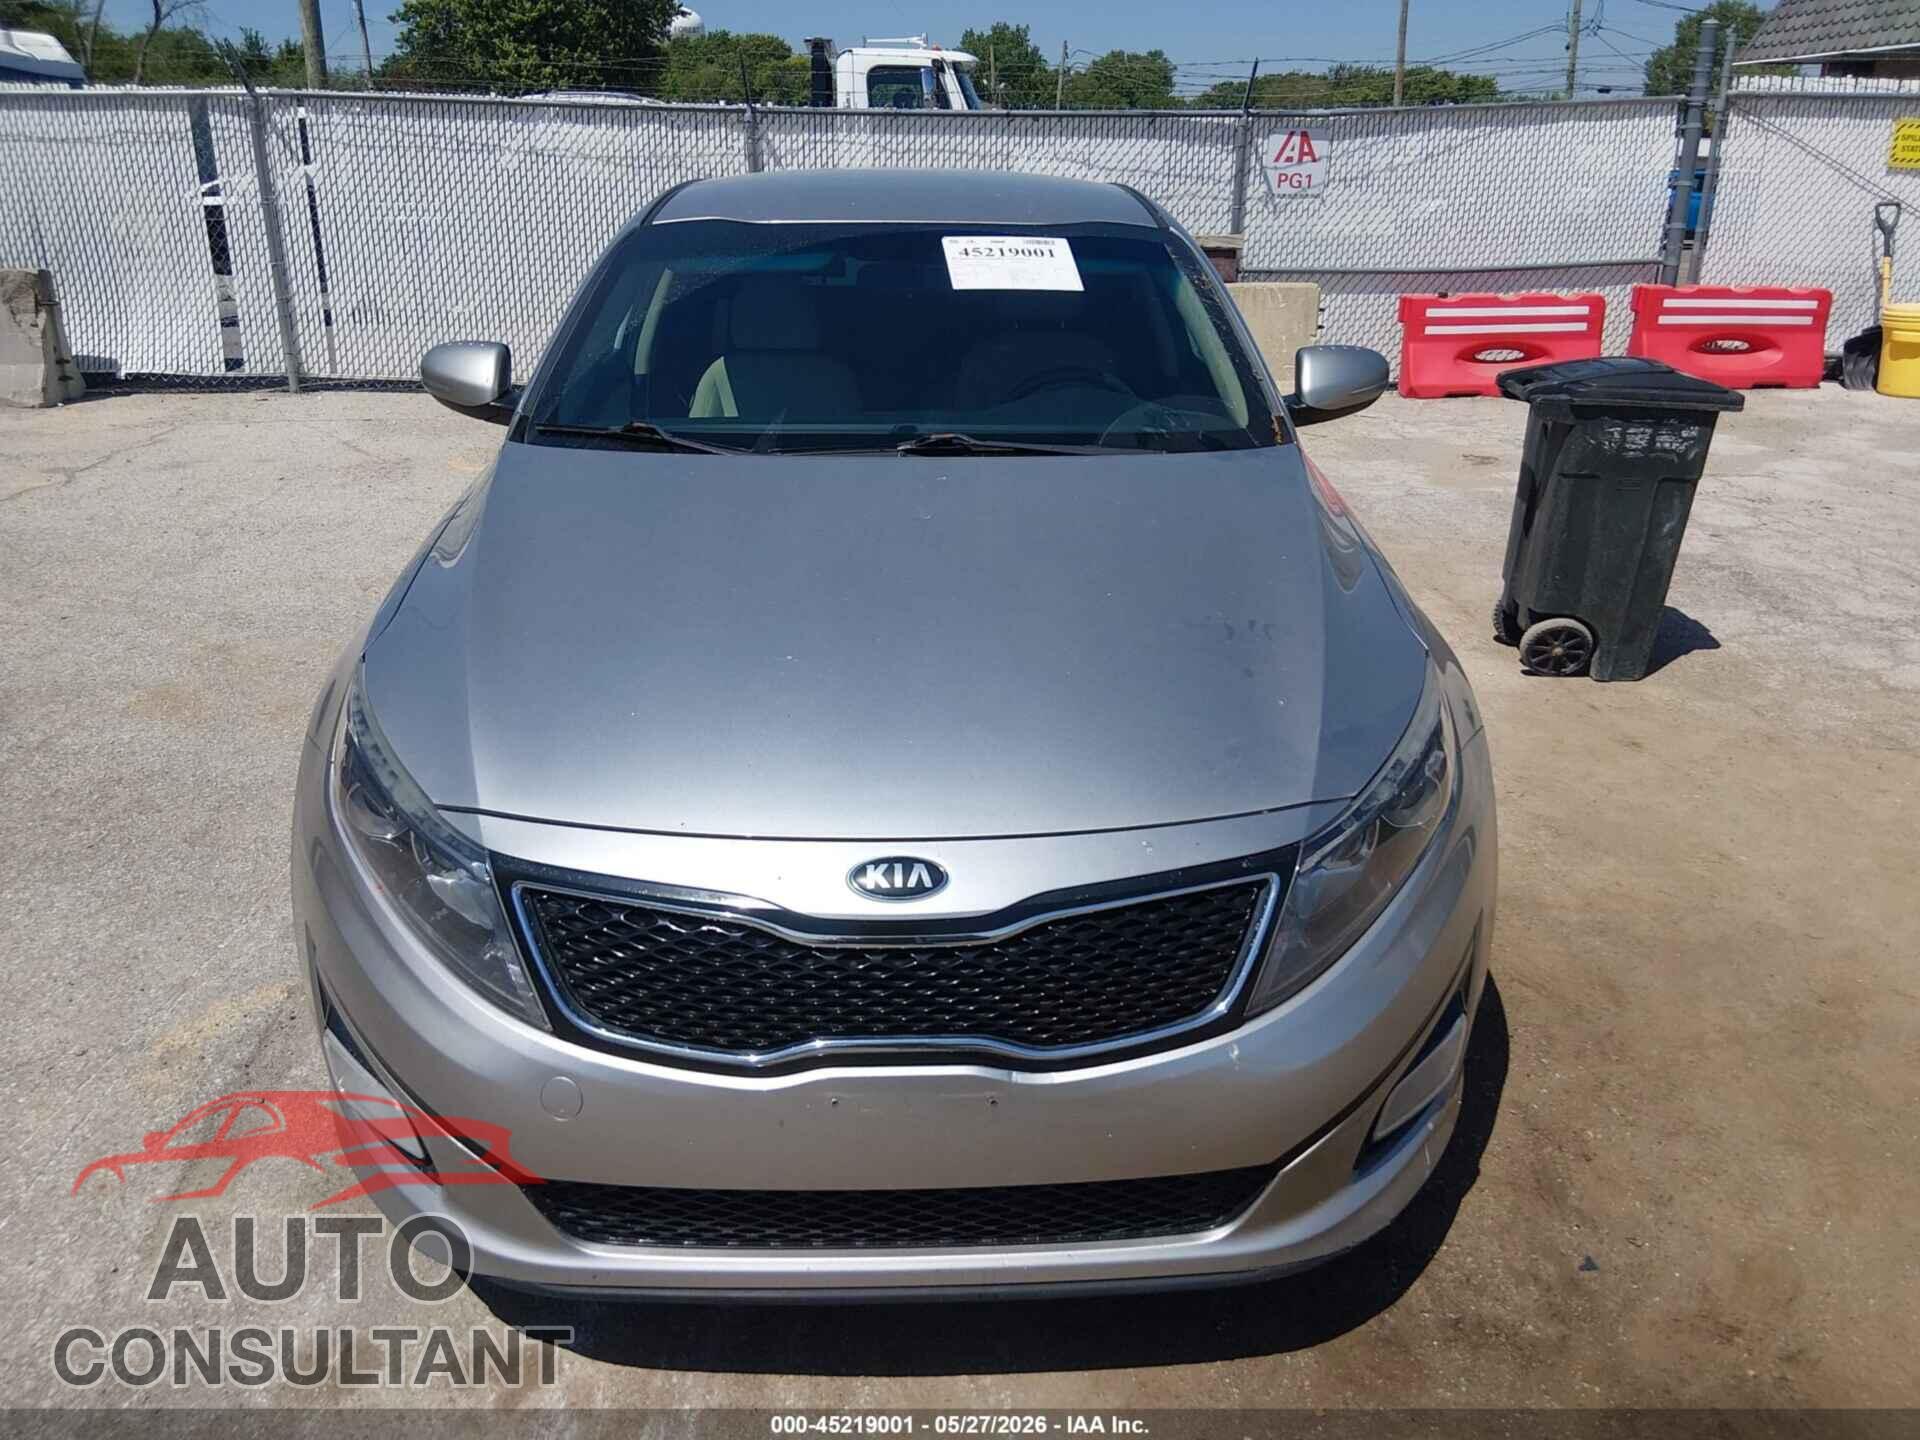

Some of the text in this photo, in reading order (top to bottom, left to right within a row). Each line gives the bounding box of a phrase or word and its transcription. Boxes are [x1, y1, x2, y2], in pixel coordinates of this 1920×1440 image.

[1277, 172, 1313, 189] PG1
[958, 247, 1056, 258] 45219001
[866, 863, 933, 889] KIA
